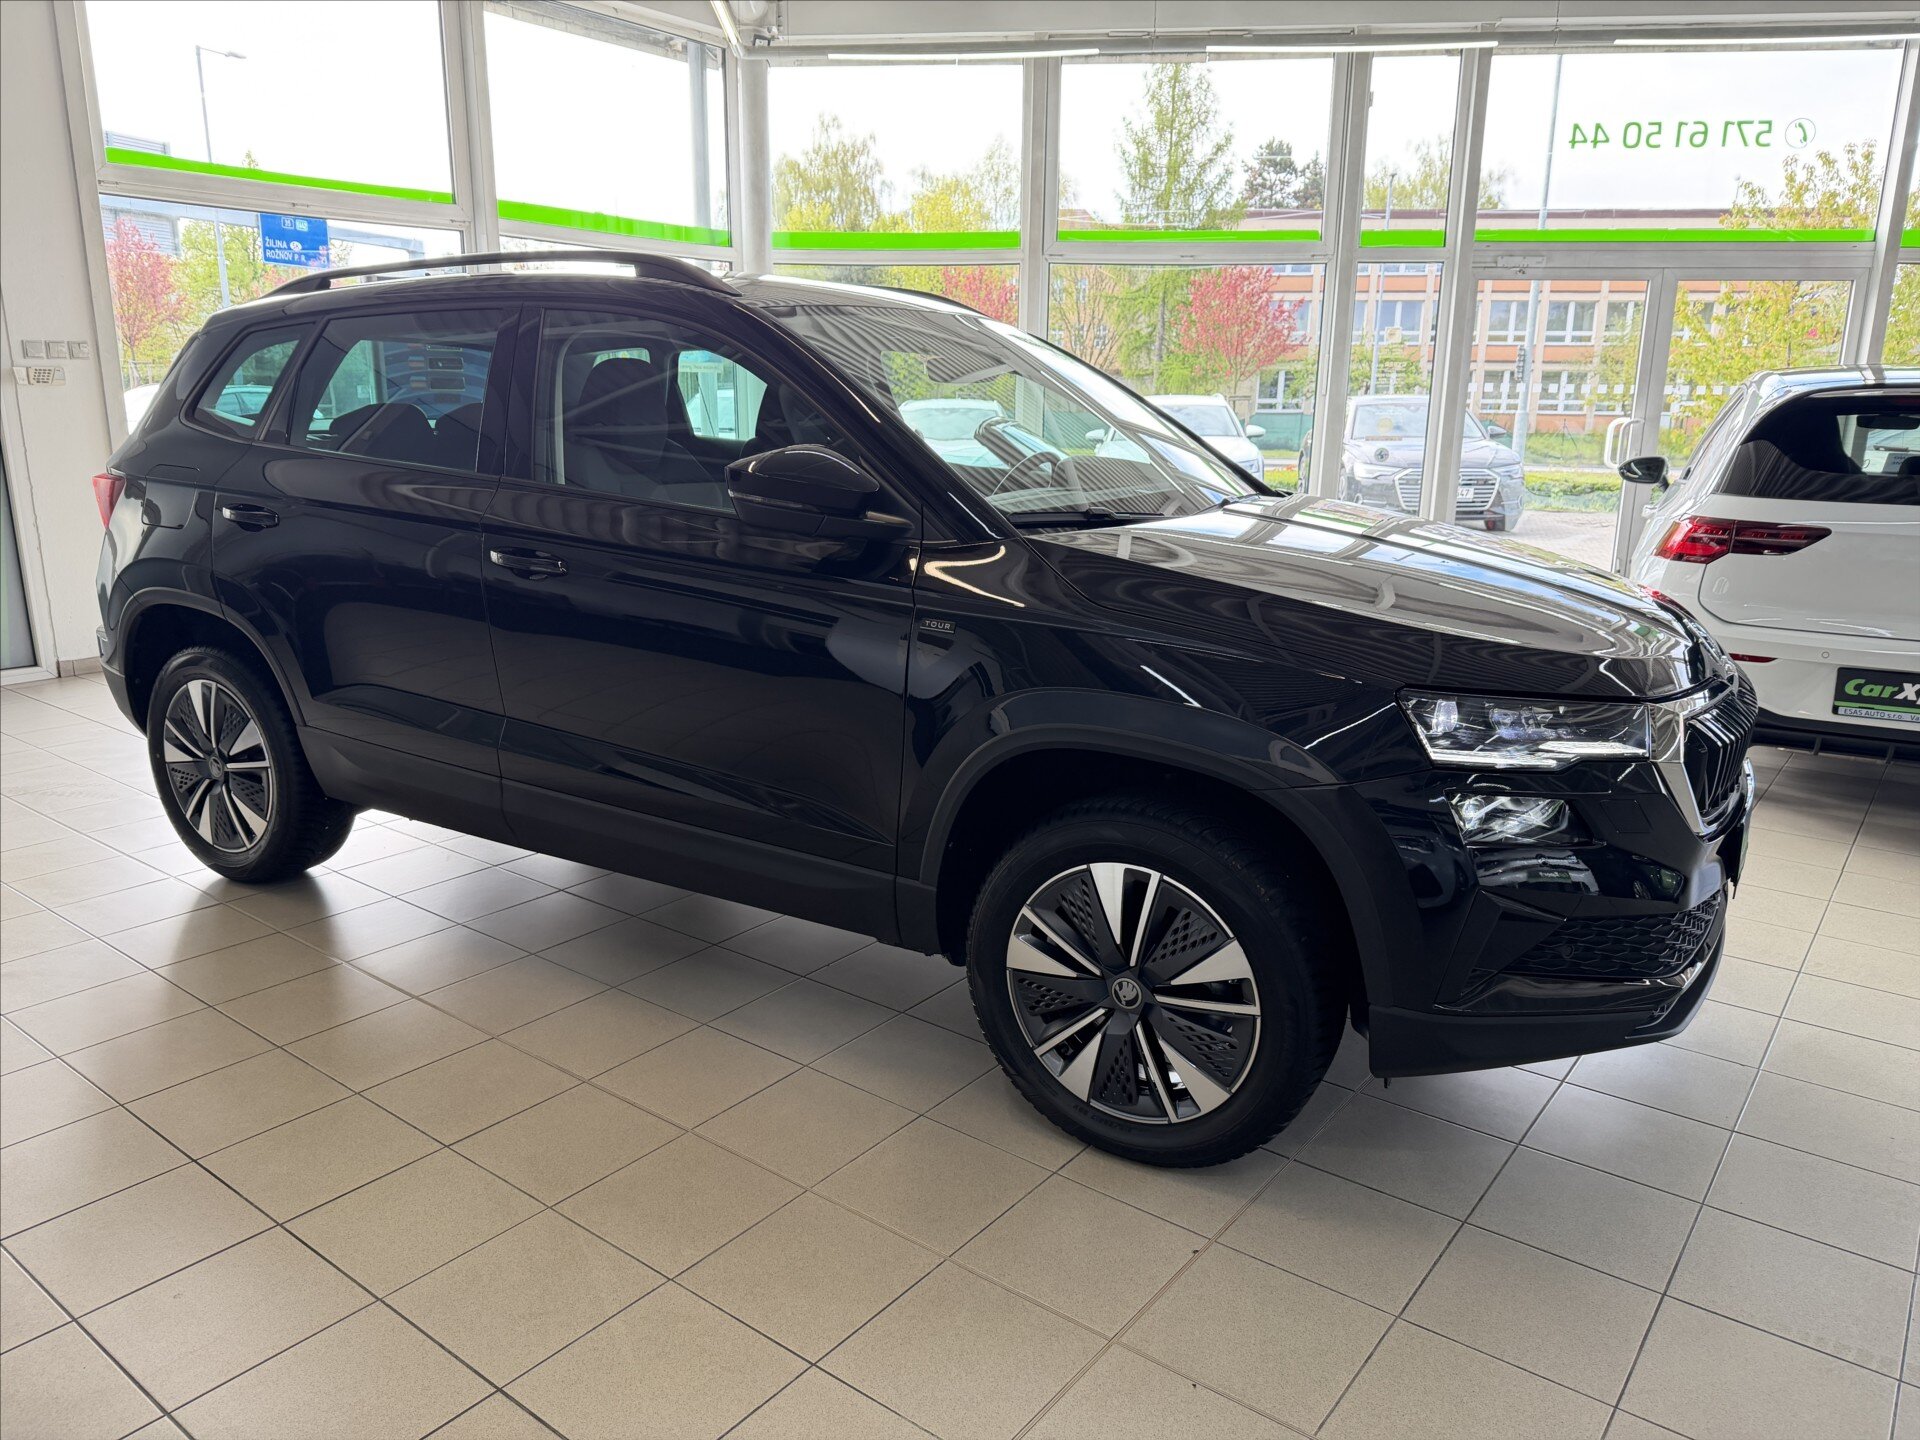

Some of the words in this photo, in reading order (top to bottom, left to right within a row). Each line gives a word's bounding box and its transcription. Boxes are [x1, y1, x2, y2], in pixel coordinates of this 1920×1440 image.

[265, 236, 288, 249] ŽILINA
[265, 249, 293, 260] ROŽNOV
[925, 620, 951, 629] TOUR
[1844, 678, 1920, 705] CarX
[1864, 710, 1886, 718] AUTO
